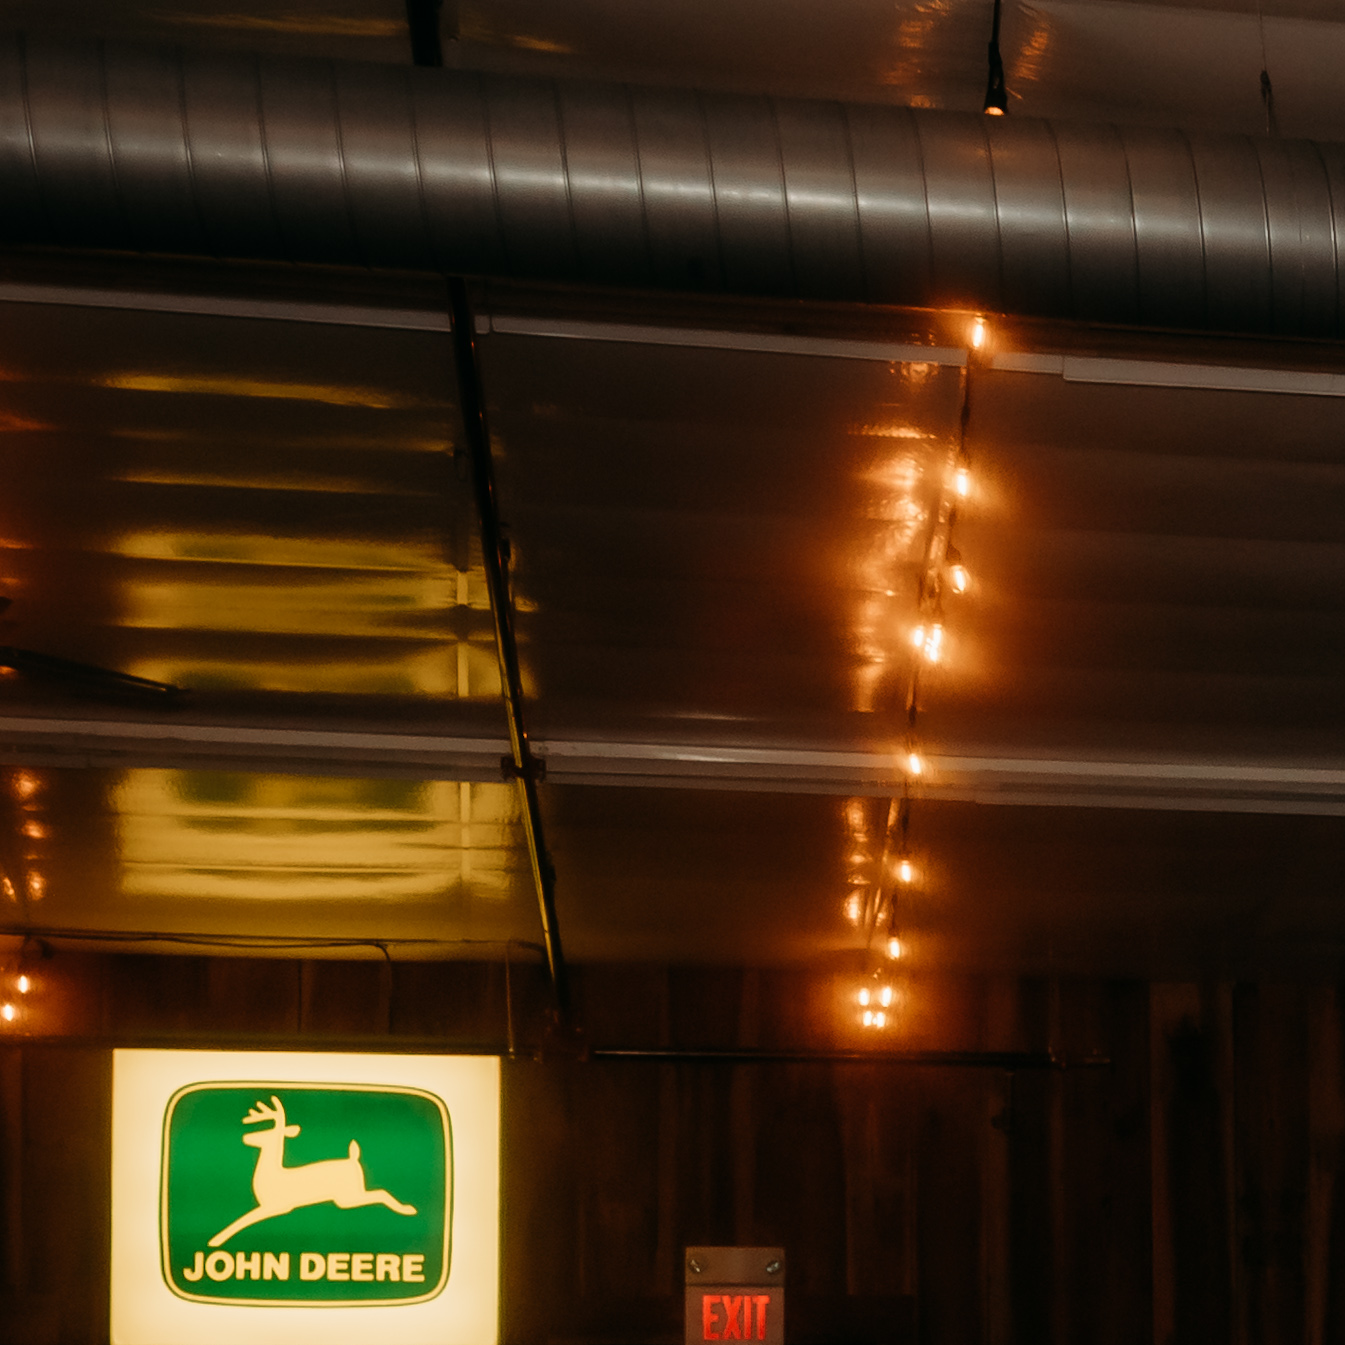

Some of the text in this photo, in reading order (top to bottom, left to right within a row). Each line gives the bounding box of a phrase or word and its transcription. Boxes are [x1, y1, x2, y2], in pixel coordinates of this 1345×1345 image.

[184, 1251, 425, 1283] JOHN DEERE
[702, 1294, 771, 1340] EXIT
